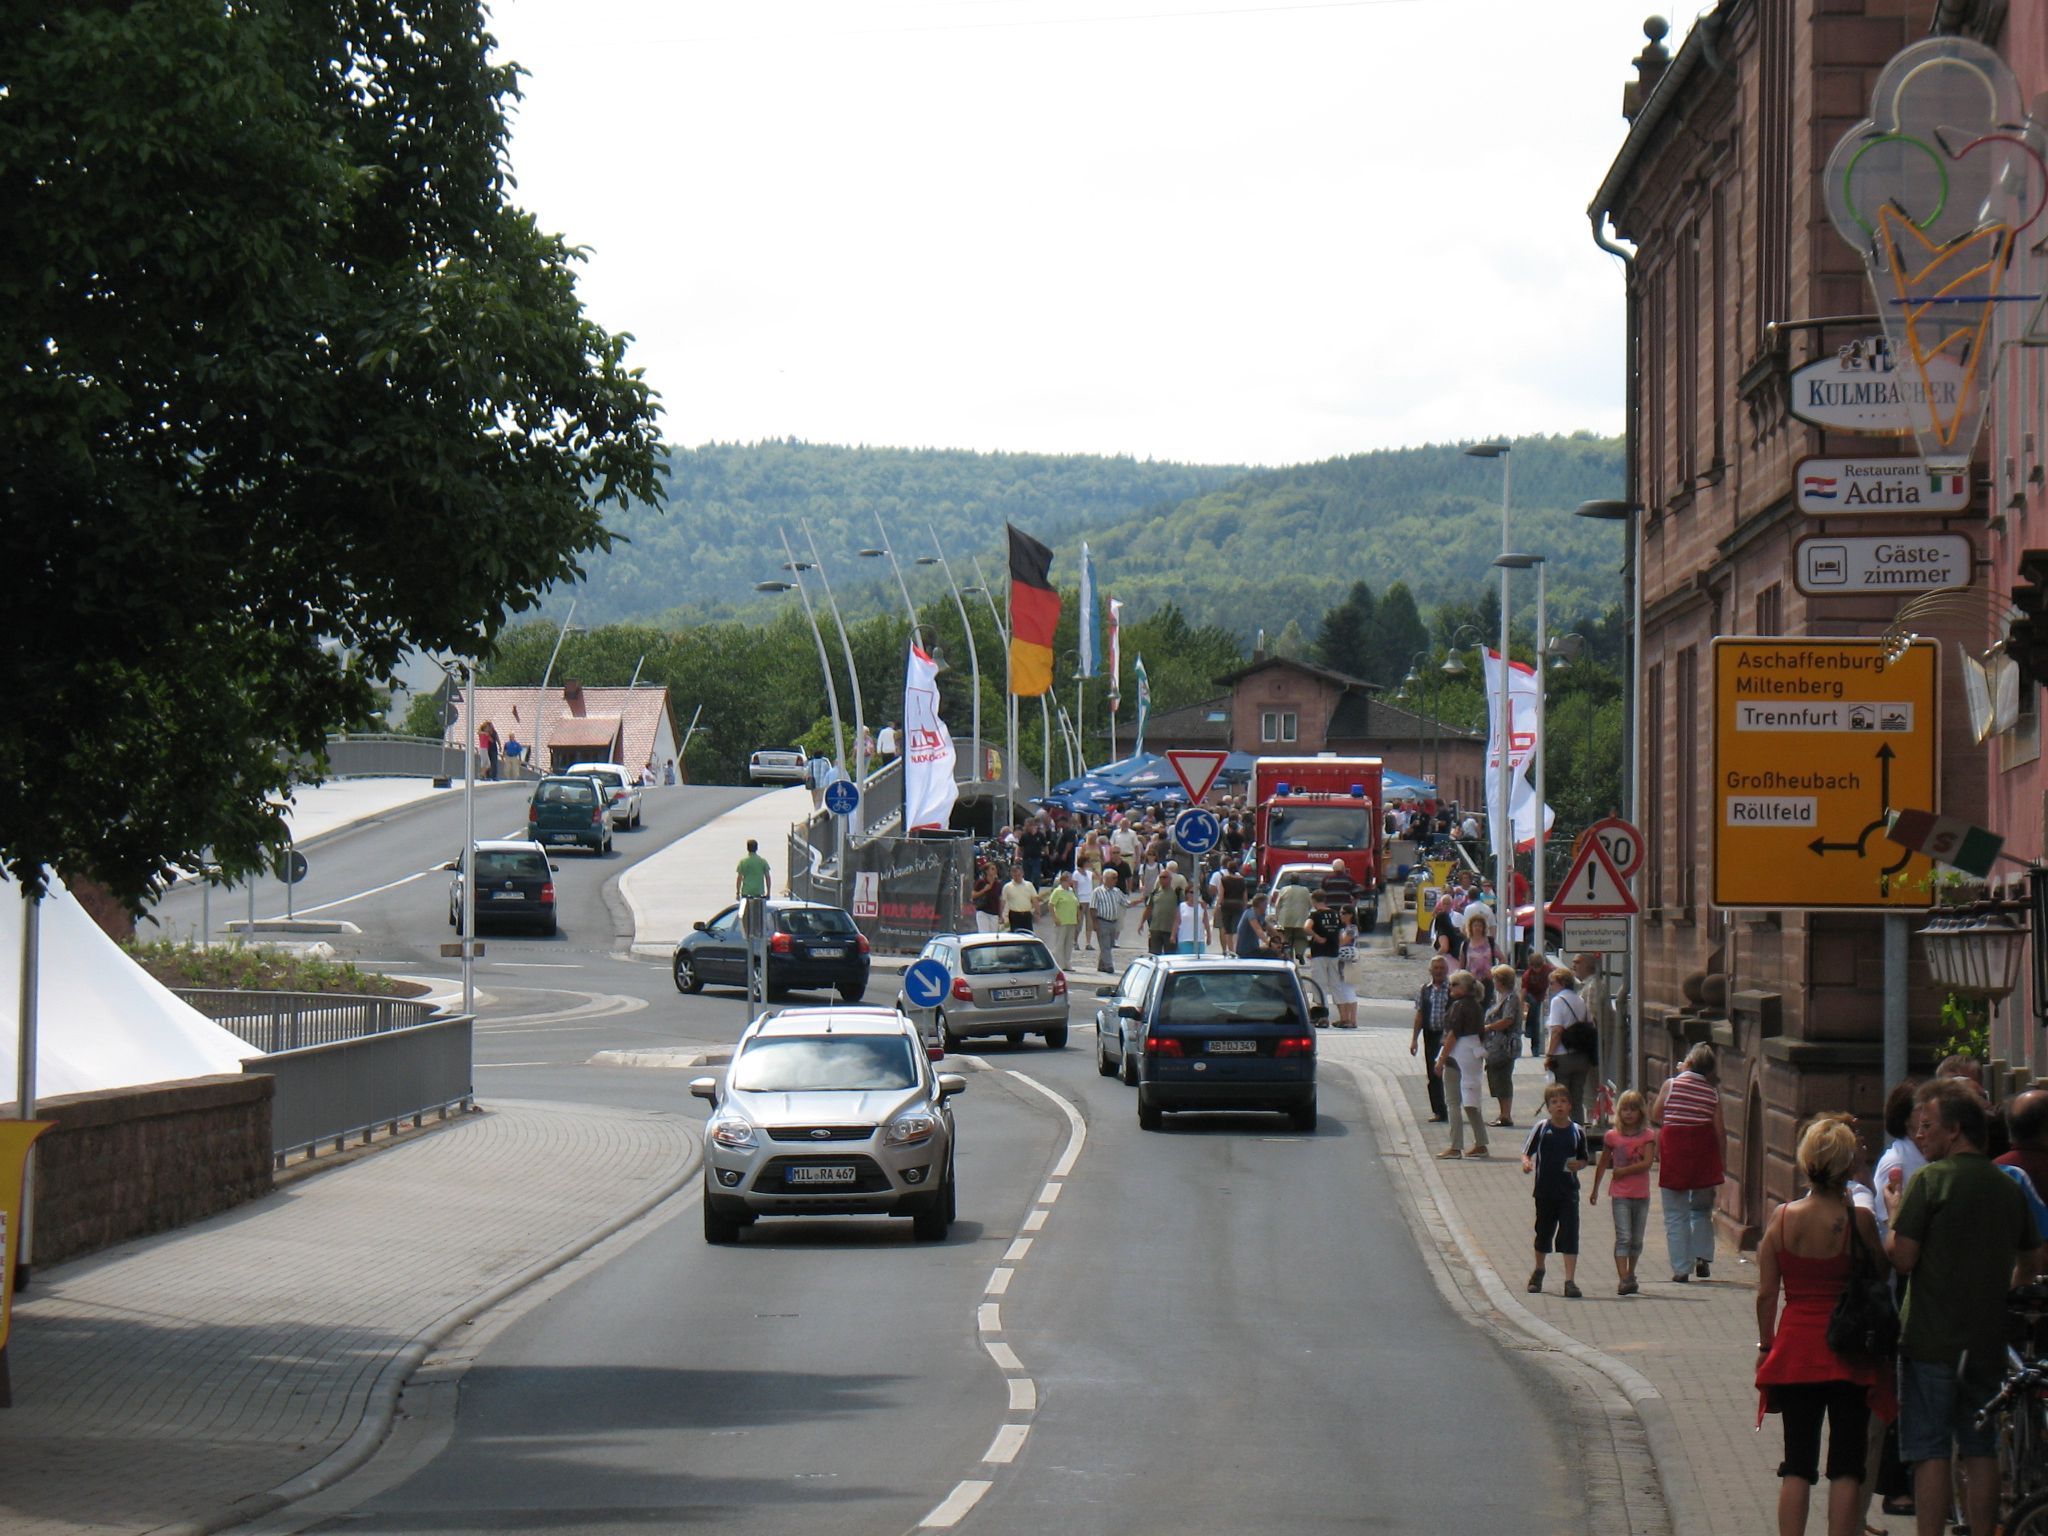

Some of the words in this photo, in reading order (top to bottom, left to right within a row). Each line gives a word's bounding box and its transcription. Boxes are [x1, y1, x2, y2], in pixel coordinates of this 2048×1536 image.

[1808, 379, 1956, 406] KULMBACHER
[1844, 464, 1921, 477] Restaurant
[1843, 481, 1921, 505] Adria
[1874, 544, 1950, 564] Gäste-
[1864, 567, 1951, 585] zimmer
[1737, 651, 1886, 673] Aschaffenburg
[1736, 677, 1843, 698] Miltenberg
[1744, 707, 1838, 726] Trennfurt
[1727, 771, 1860, 790] Großheubach
[1733, 802, 1811, 821] Röllfeld
[836, 1168, 855, 1179] 467
